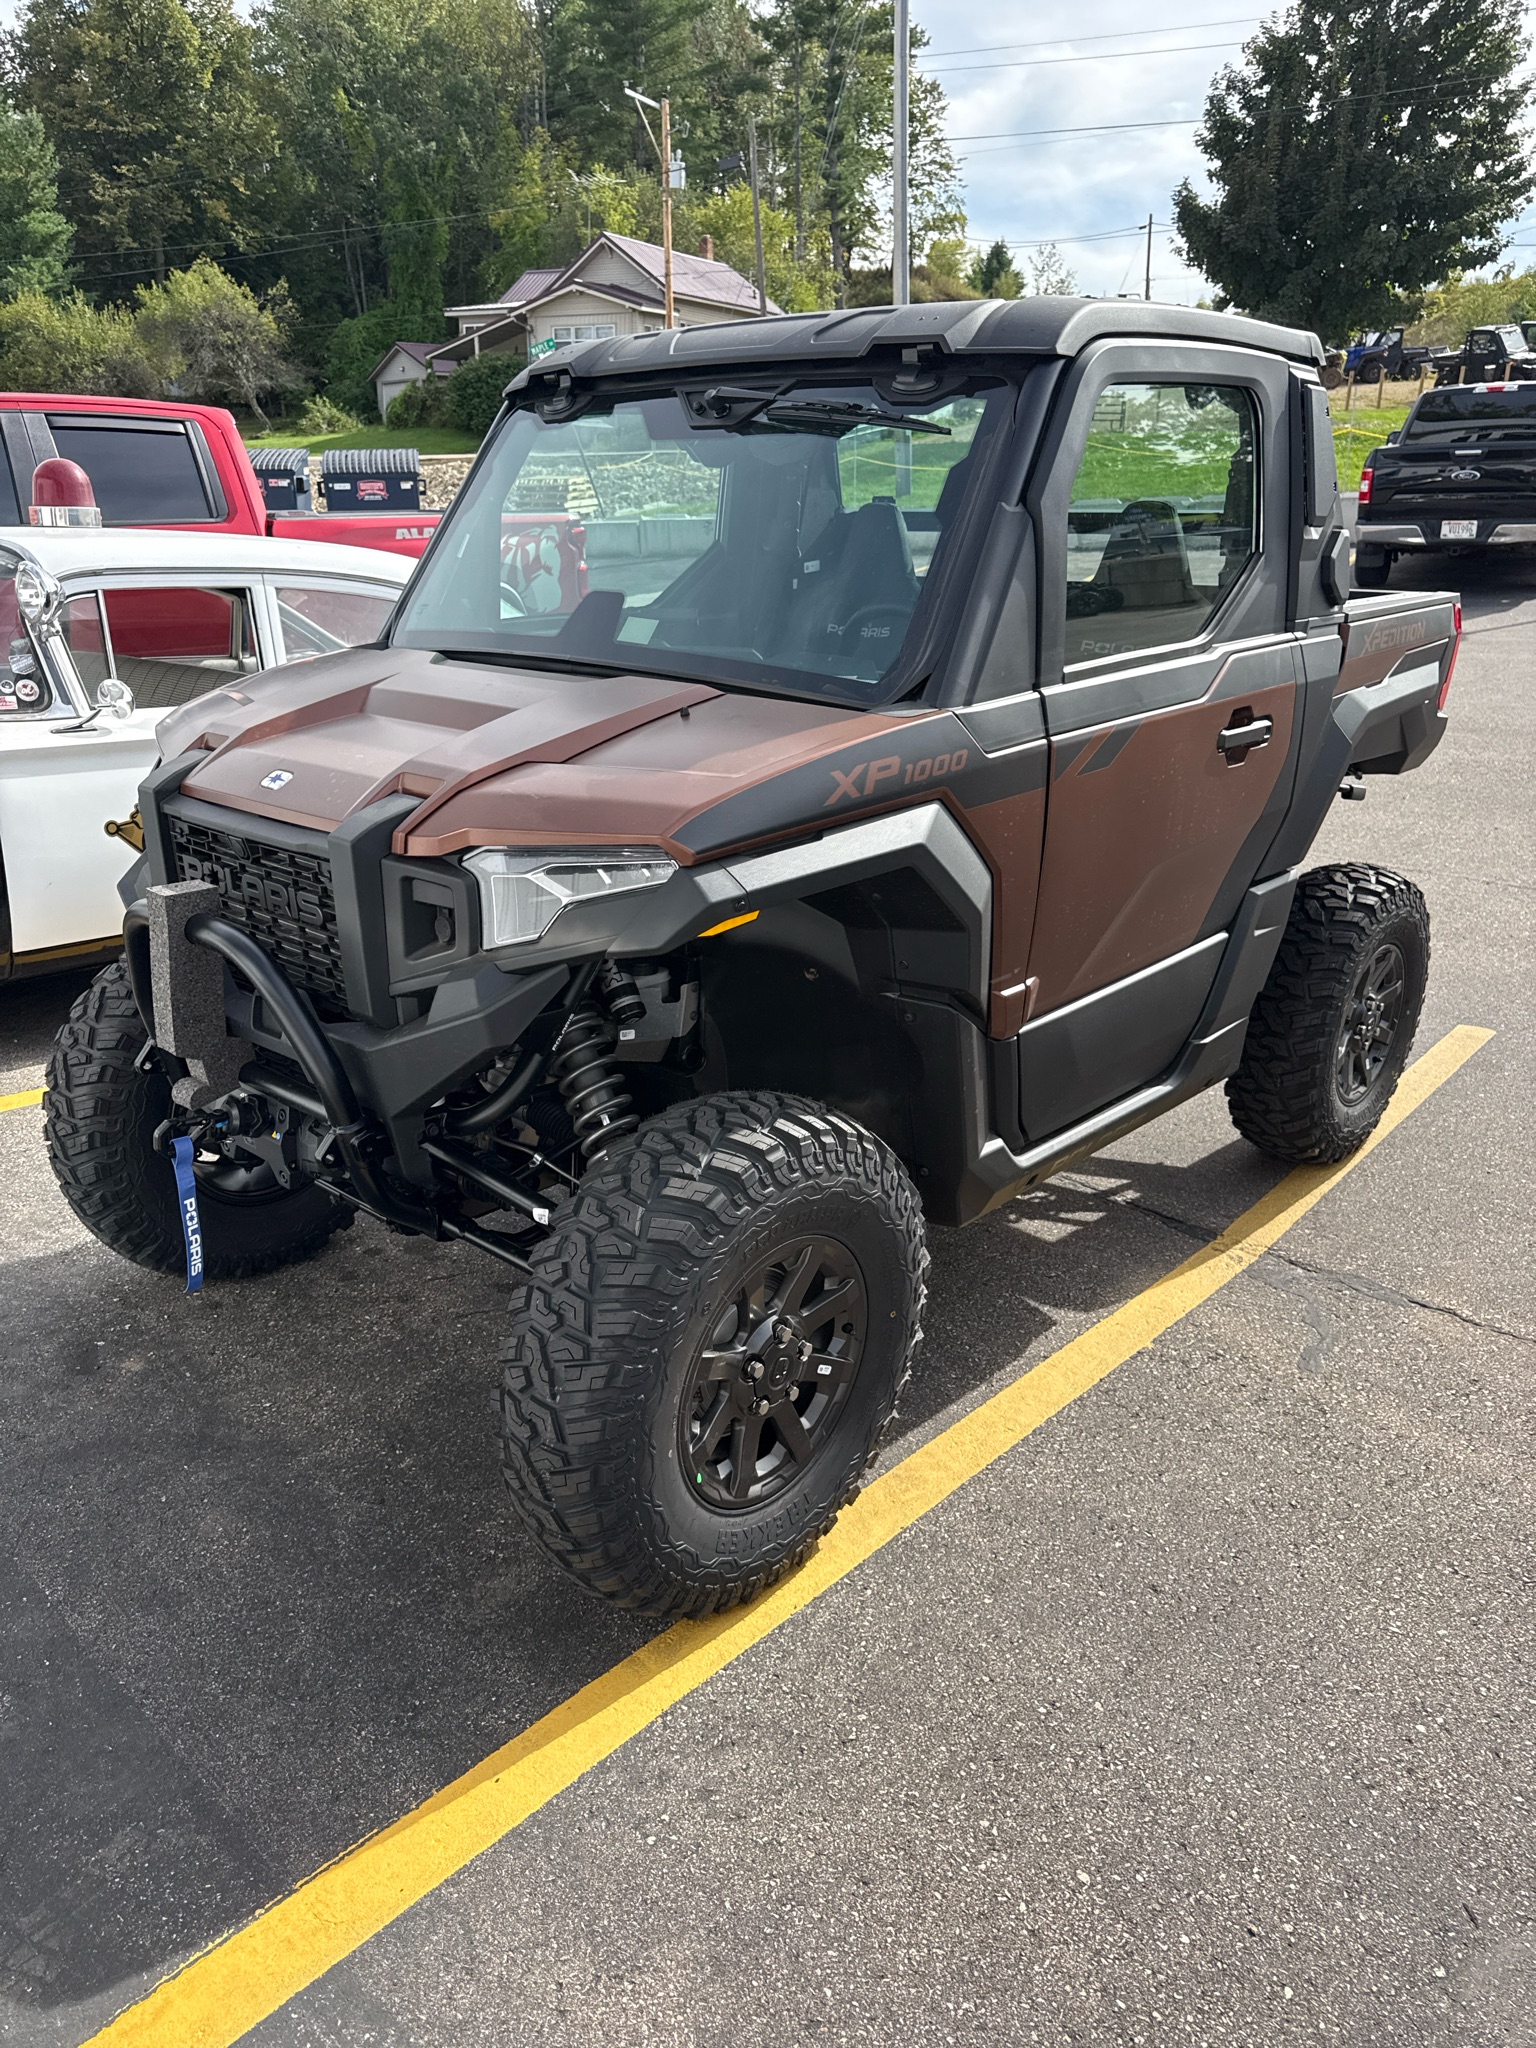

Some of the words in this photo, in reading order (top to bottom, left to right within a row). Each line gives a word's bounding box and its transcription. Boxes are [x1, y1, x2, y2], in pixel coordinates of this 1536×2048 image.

[823, 754, 901, 807] XP
[904, 748, 969, 785] 1000
[181, 853, 324, 927] POLARIS
[183, 1196, 202, 1277] POLARIS
